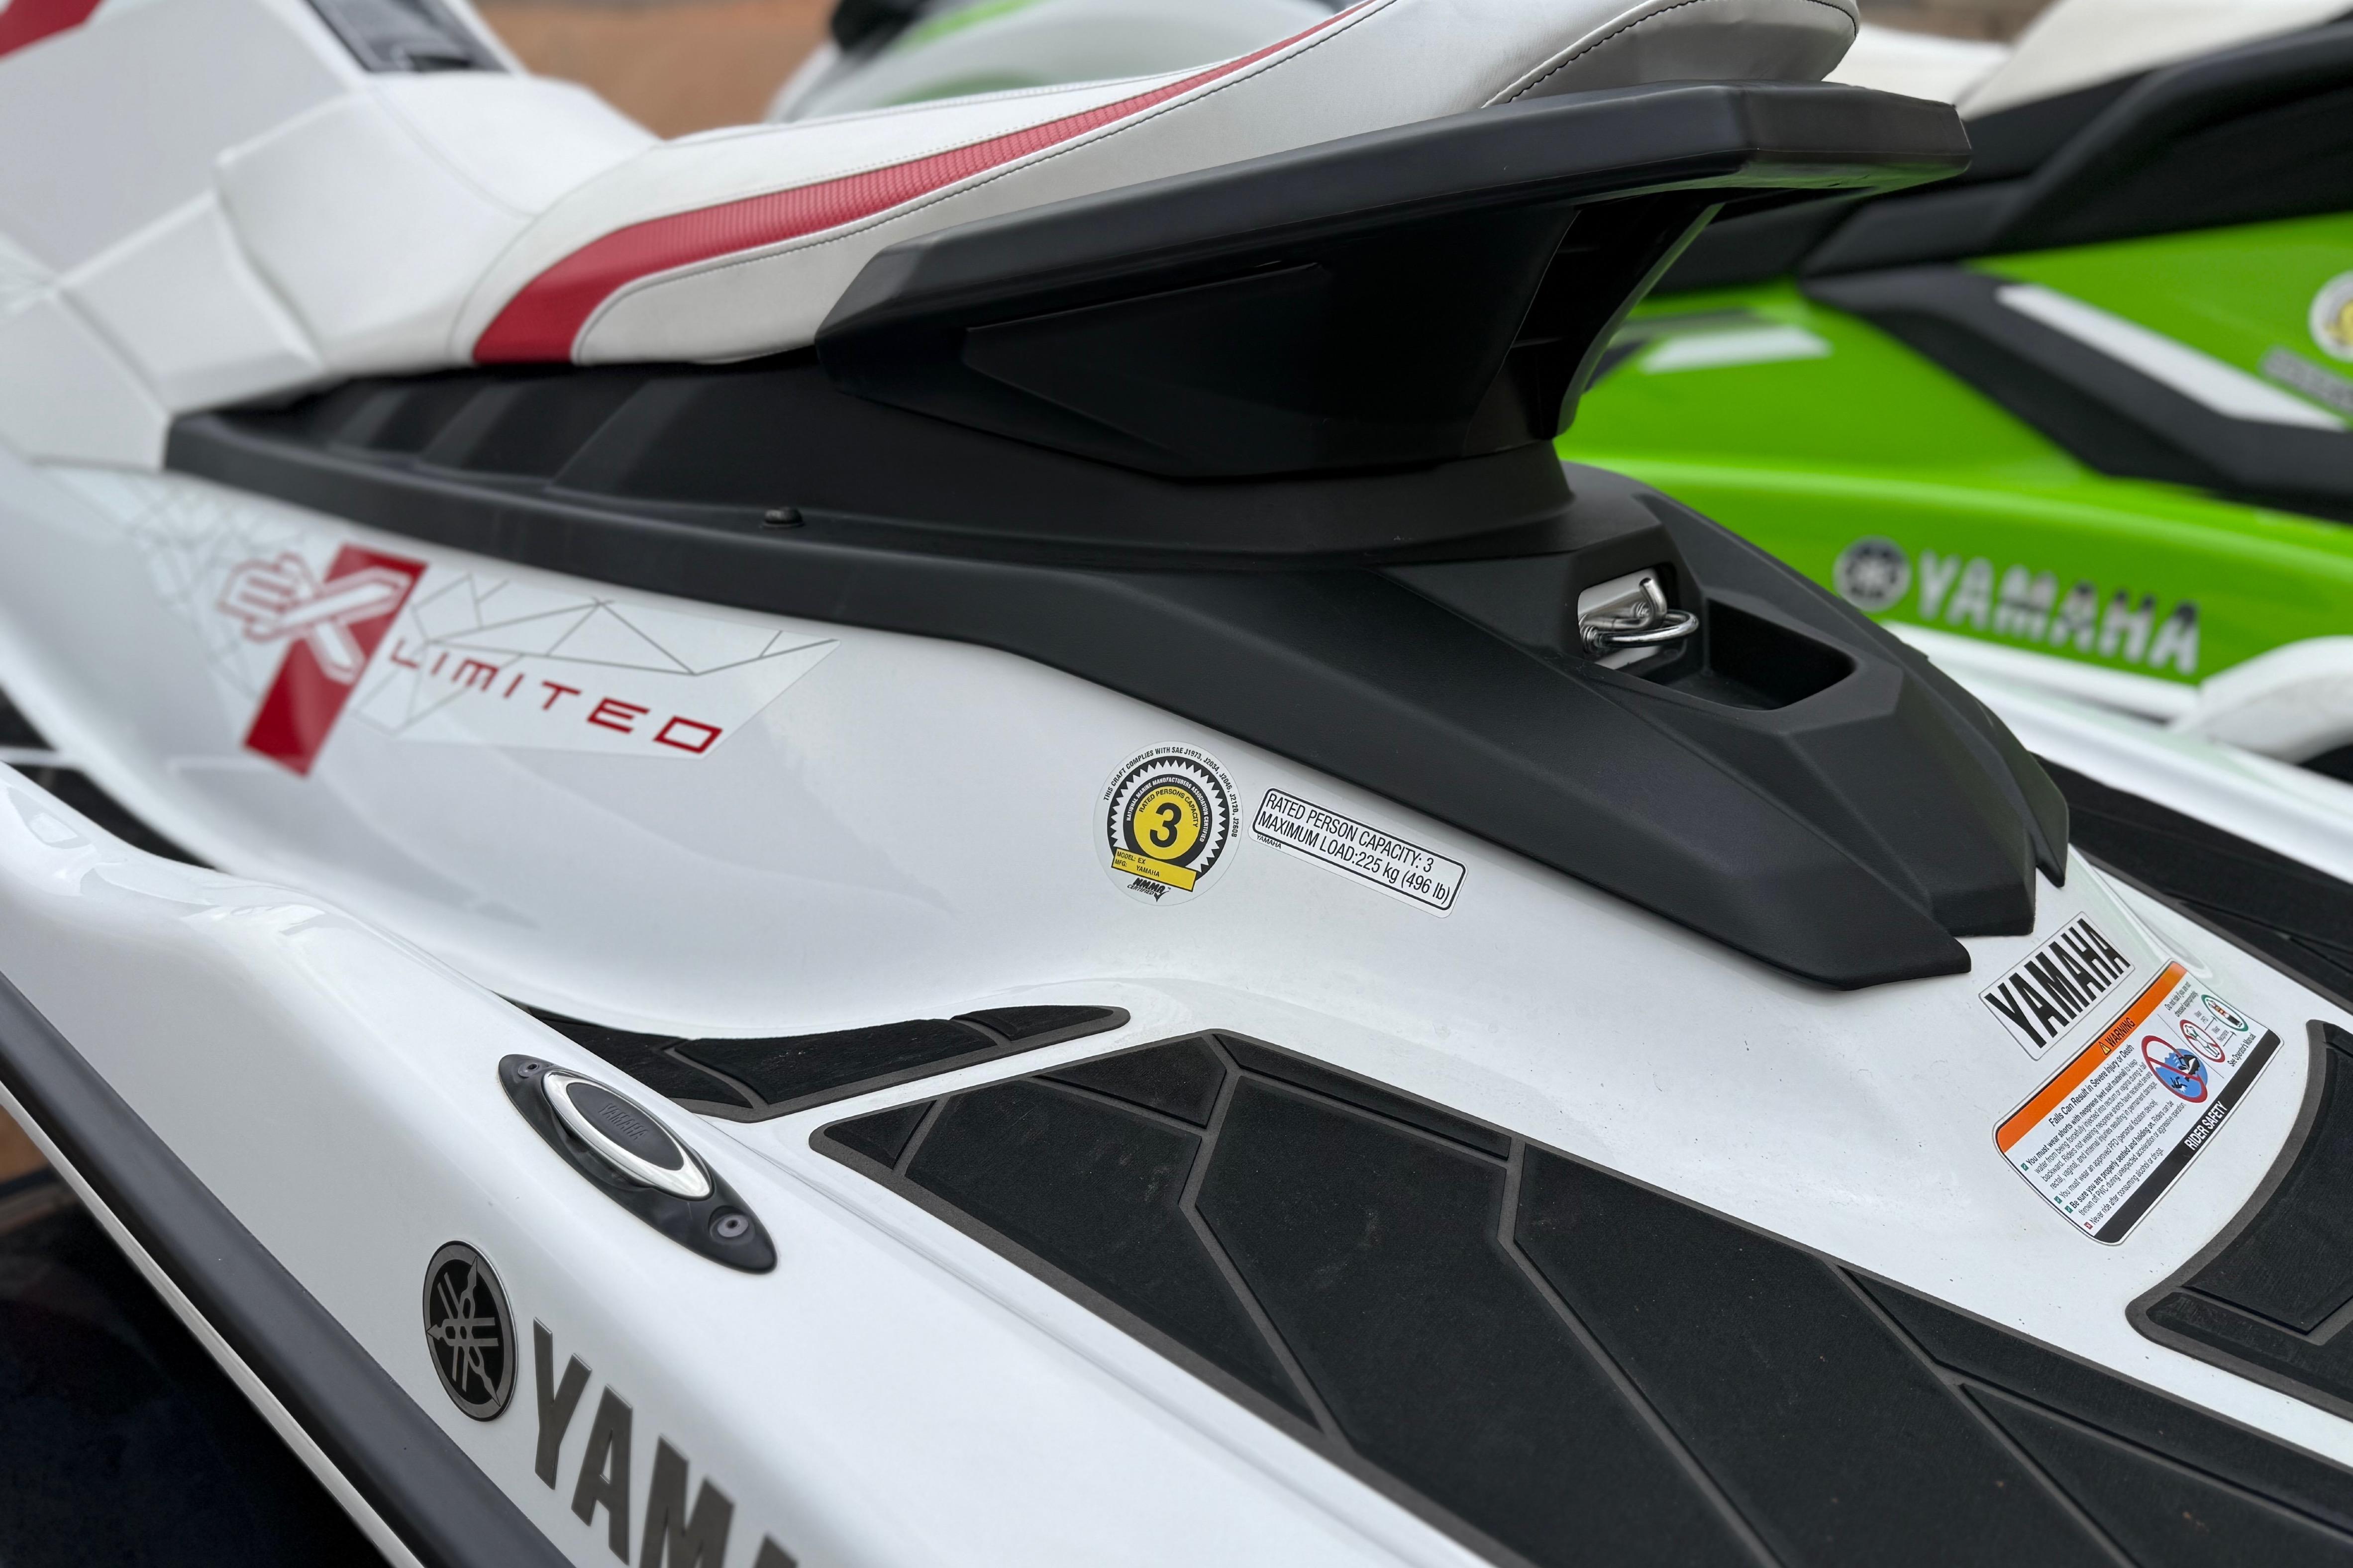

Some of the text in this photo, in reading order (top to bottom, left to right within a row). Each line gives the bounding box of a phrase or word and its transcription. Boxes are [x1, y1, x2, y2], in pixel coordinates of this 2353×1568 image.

[1917, 549, 2200, 675] YAMAHA
[390, 639, 723, 755] LIMITED
[1104, 787, 1113, 800] THIS
[1111, 768, 1126, 786] CRAFT
[1126, 750, 1153, 770] COMPLIES
[1184, 747, 1202, 761] J1973,
[1204, 757, 1220, 773] J2034,
[1219, 773, 1233, 792] J2046,
[1229, 794, 1239, 816] J2120,
[1139, 788, 1199, 827] RATED PERSONS CAPACITY
[1117, 851, 1136, 862] MODEL:
[1150, 802, 1182, 848] 3
[1257, 834, 1281, 849] YAMAHA
[1259, 811, 1319, 846] MAXIMUM
[1383, 862, 1400, 883] kg
[1401, 871, 1432, 893] (496
[1432, 882, 1449, 904] lb)
[1266, 793, 1433, 872] RATED PERSON CAPACITY: 3
[1115, 859, 1160, 877] MFG: YAMAHA
[1127, 884, 1154, 894] CERTIFIED
[1132, 878, 1165, 893] NMMA
[1984, 918, 2131, 1049] YAMAHA
[2105, 1017, 2135, 1047] WARNING
[2232, 1044, 2248, 1060] Operator's
[2243, 1033, 2256, 1045] Manual
[598, 1102, 648, 1141] YAMAHA
[2026, 1156, 2038, 1166] You
[2036, 1145, 2049, 1158] must
[2047, 1135, 2059, 1147] wear
[2058, 1123, 2072, 1137] shorts
[2071, 1115, 2081, 1125] with
[2079, 1098, 2098, 1117] neoprene
[2096, 1089, 2107, 1101] (wet
[2105, 1082, 2113, 1092] suit
[2111, 1069, 2128, 1085] material)
[2127, 1059, 2138, 1068] keep
[2035, 1161, 2048, 1174] water
[2045, 1152, 2057, 1163] from
[2054, 1141, 2070, 1154] being
[2066, 1125, 2086, 1143] forcefully
[2082, 1110, 2099, 1127] injected
[2096, 1105, 2106, 1113] into
[2104, 1093, 2118, 1107] rectum
[2119, 1079, 2132, 1091] vagina
[2129, 1070, 2142, 1081] during
[2048, 1113, 2064, 1126] Falls
[2061, 1103, 2074, 1114] Can
[2071, 1088, 2089, 1105] Result
[2090, 1071, 2108, 1087] Severe
[2104, 1060, 2119, 1074] Injury
[2120, 1045, 2134, 1058] Death
[2041, 1072, 2152, 1181] backward. Riders not wearing neoprene shorts have received severe
[2050, 1175, 2065, 1189] rectal,
[2062, 1161, 2080, 1176] vaginal,
[2077, 1152, 2087, 1163] and
[2083, 1138, 2100, 1155] internal
[2097, 1125, 2112, 1142] injuries
[2110, 1113, 2127, 1130] resulting
[2128, 1092, 2146, 1113] permanent
[2143, 1081, 2157, 1095] damage.
[2059, 1189, 2070, 1198] You
[2068, 1178, 2080, 1191] must
[2078, 1170, 2089, 1181] wear
[2093, 1146, 2111, 1167] approved
[2108, 1139, 2119, 1150] PFD
[2116, 1123, 2134, 1143] (personal
[2077, 1191, 2088, 1202] sure
[2086, 1183, 2096, 1194] you
[2094, 1176, 2103, 1185] are
[2101, 1160, 2119, 1179] properly
[2116, 1146, 2130, 1162] seated
[2129, 1139, 2137, 1150] and
[2134, 1127, 2150, 1142] holding
[2151, 1111, 2164, 1123] Riders
[2184, 1101, 2227, 1150] RIDER SAFETY
[2078, 1201, 2094, 1215] thrown
[2095, 1185, 2108, 1197] PWC
[2106, 1175, 2121, 1188] during
[2117, 1154, 2138, 1176] unexpected
[2136, 1136, 2155, 1157] acceleration
[2157, 1116, 2173, 1134] aggressive
[2089, 1211, 2104, 1225] Never
[2101, 1204, 2111, 1213] ride
[2109, 1194, 2119, 1205] after
[2117, 1175, 2139, 1196] consuming
[2136, 1161, 2150, 1177] alcohol
[2151, 1148, 2163, 1160] drugs.
[533, 1316, 798, 1568] YAM
